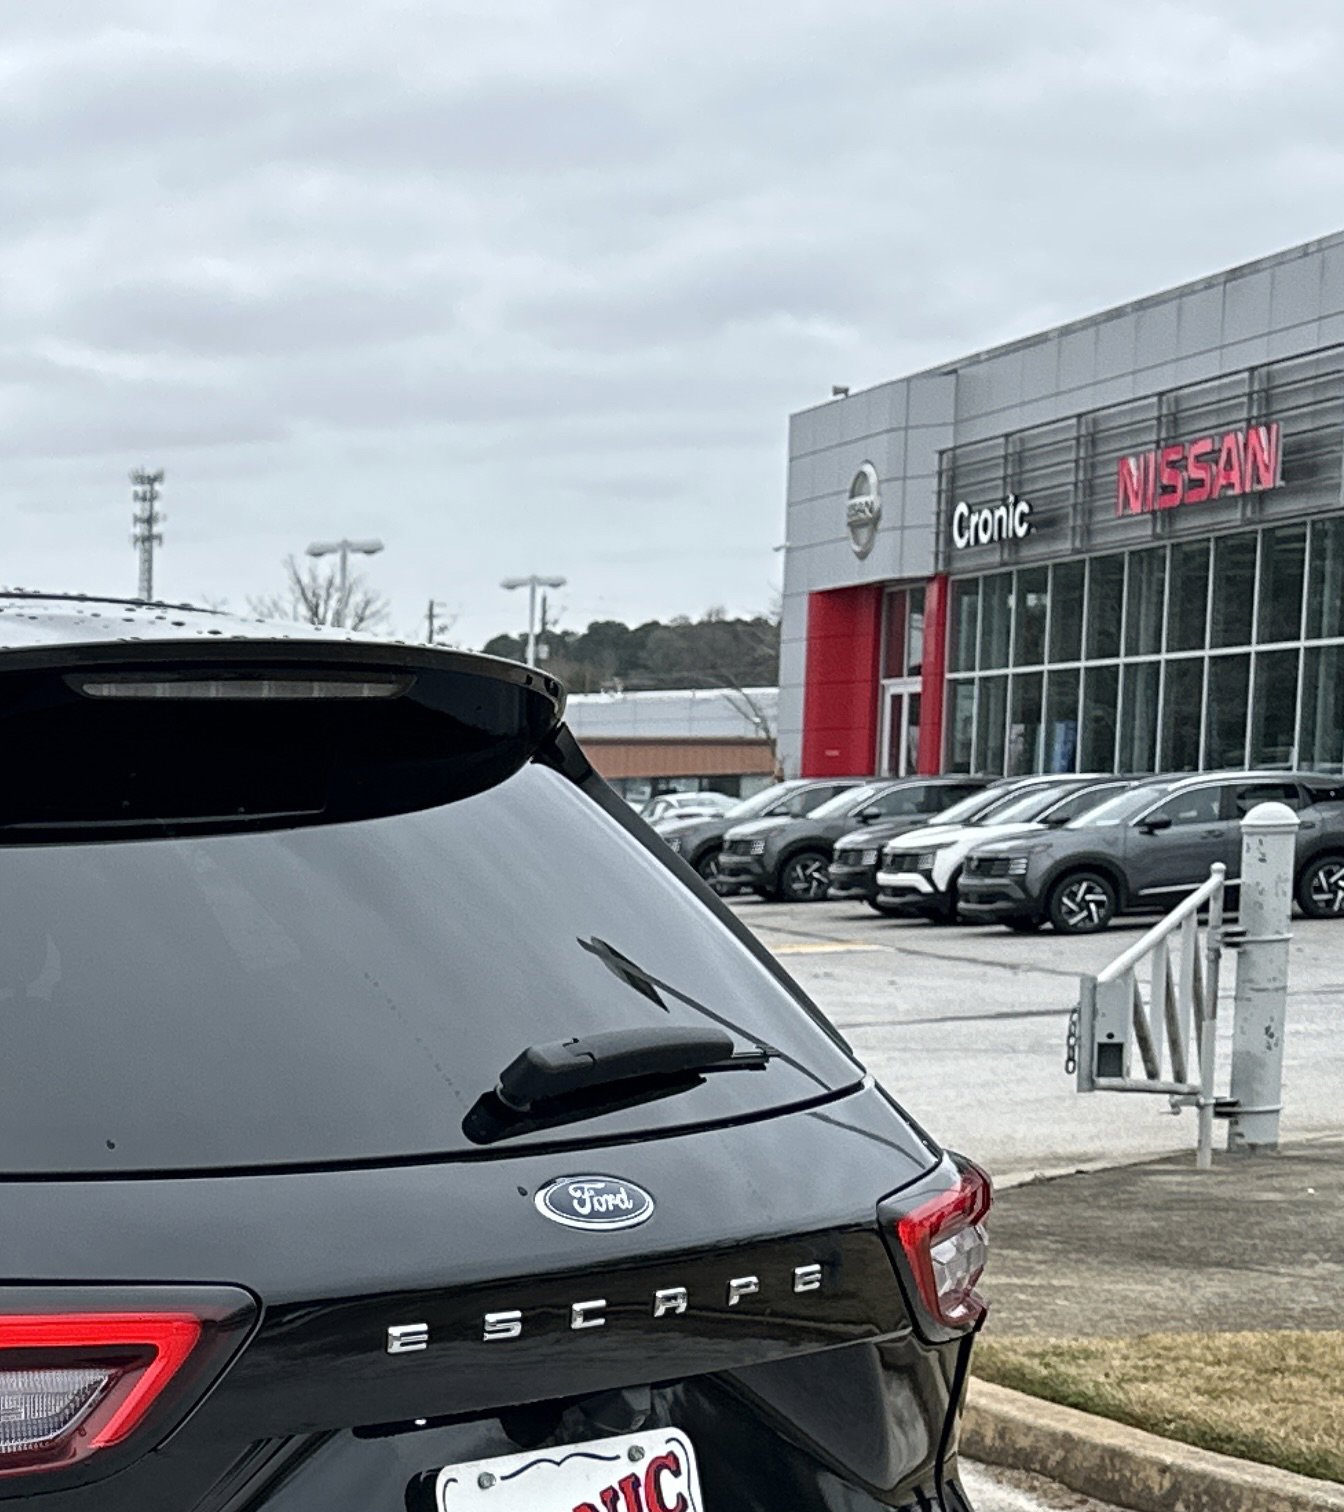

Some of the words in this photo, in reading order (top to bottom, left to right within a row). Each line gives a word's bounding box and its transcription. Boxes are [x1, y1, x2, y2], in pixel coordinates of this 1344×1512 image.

[1116, 421, 1283, 518] NISSAN
[953, 493, 1030, 549] Cronic
[568, 1182, 633, 1215] Ford
[386, 1264, 822, 1354] ESCAPE
